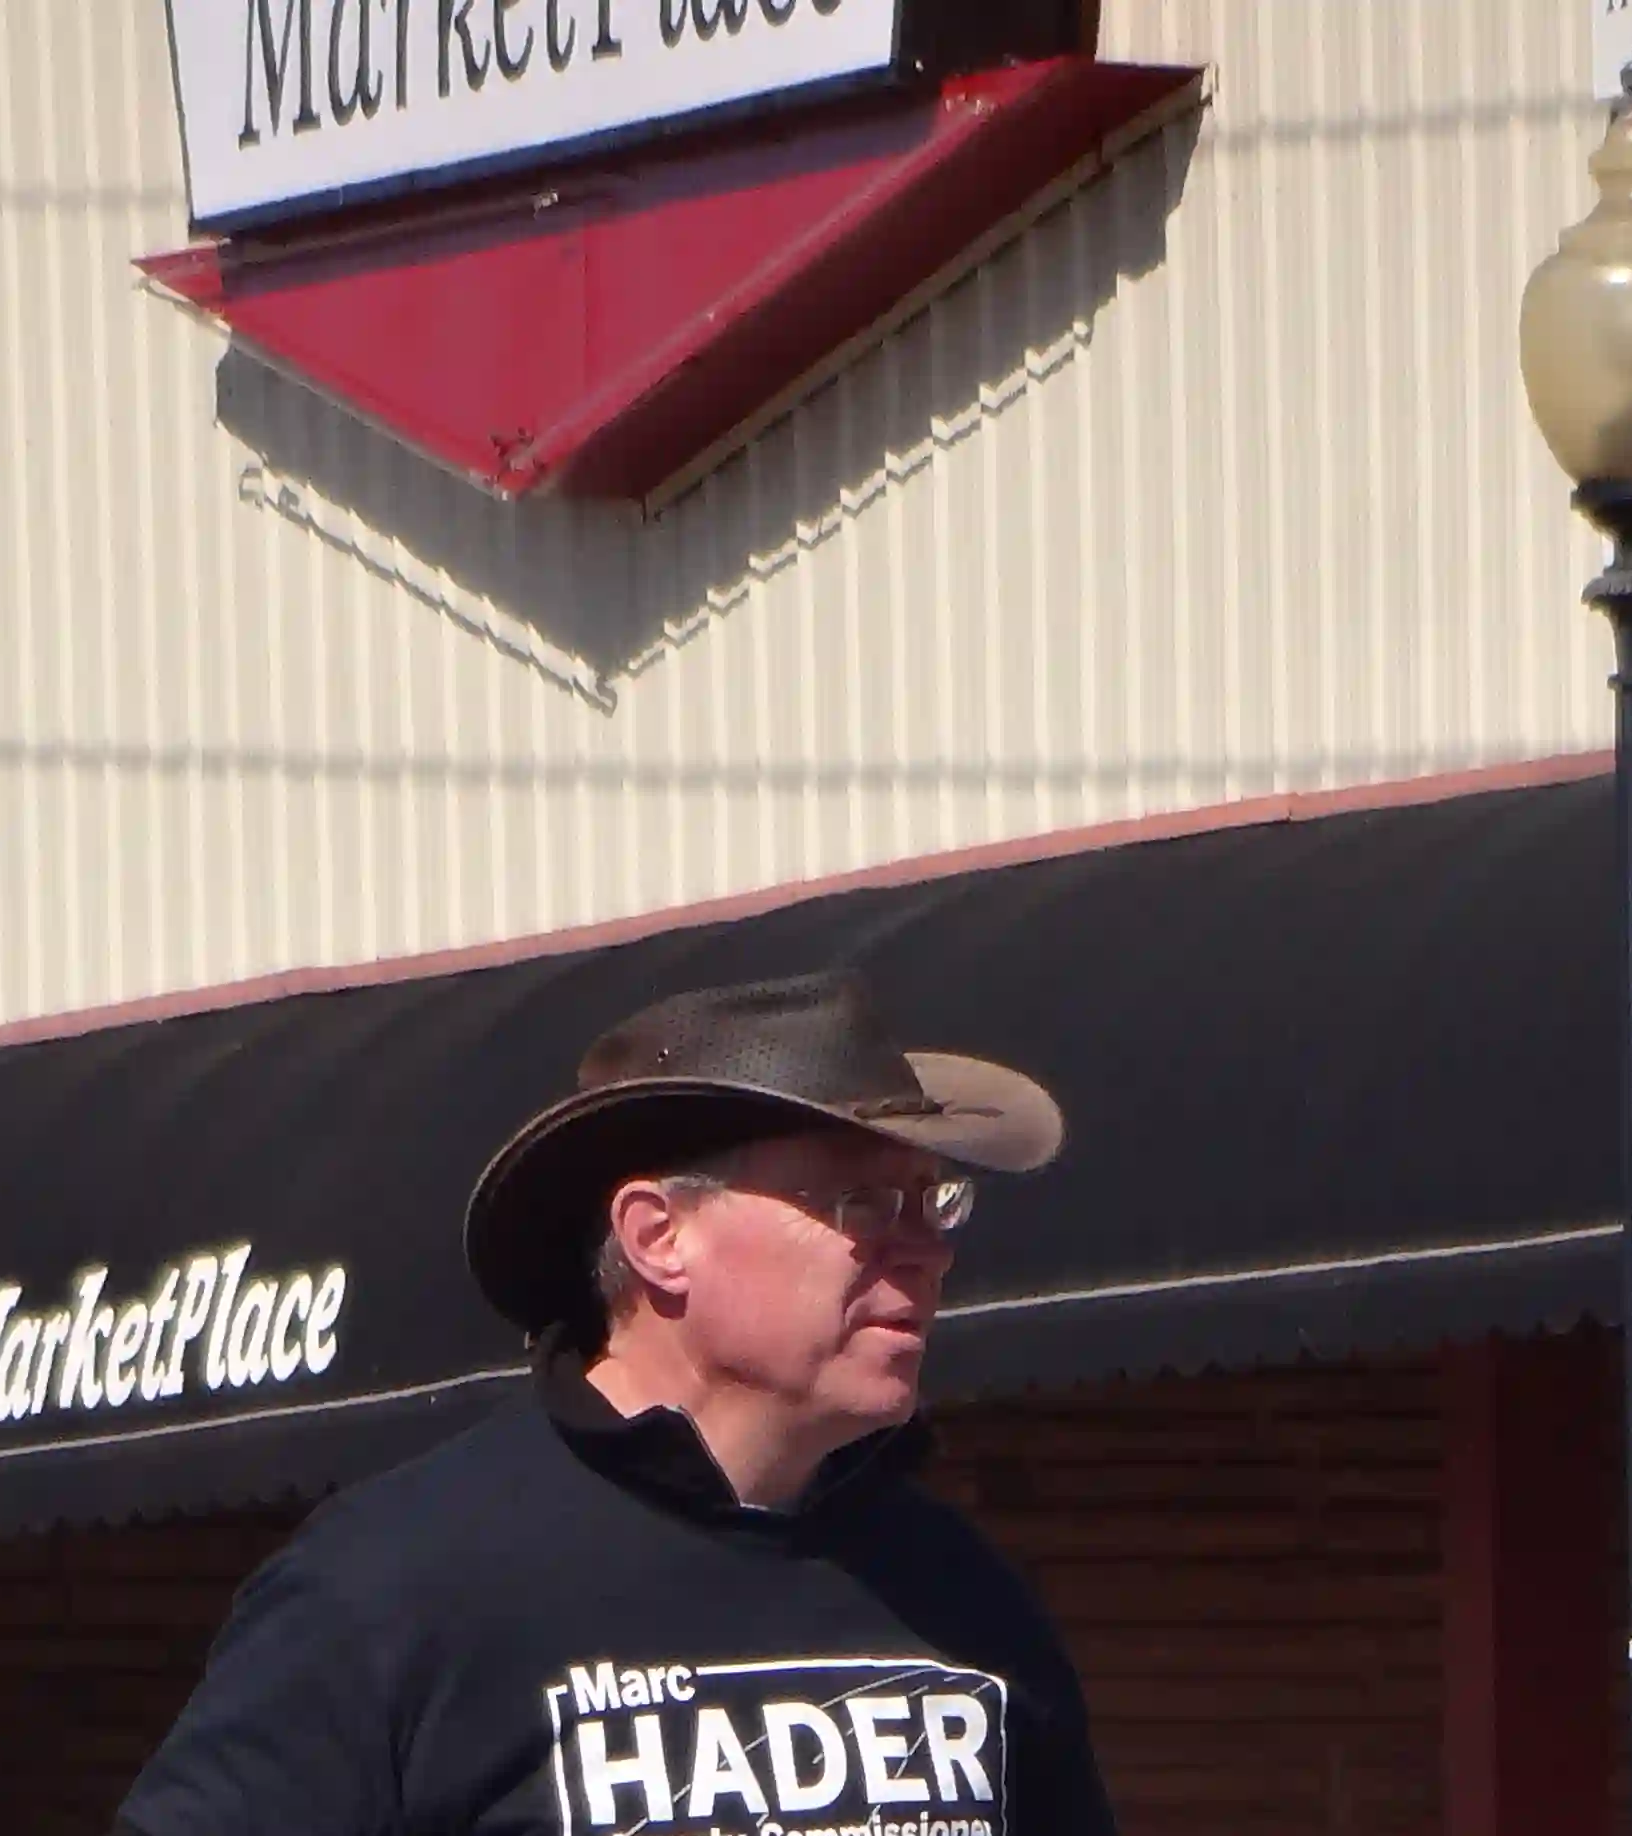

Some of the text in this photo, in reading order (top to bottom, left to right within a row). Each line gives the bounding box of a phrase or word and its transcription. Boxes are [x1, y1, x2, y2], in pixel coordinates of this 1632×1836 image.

[236, 0, 846, 150] Market
[570, 1661, 696, 1716] Marc
[575, 1692, 995, 1826] HADER
